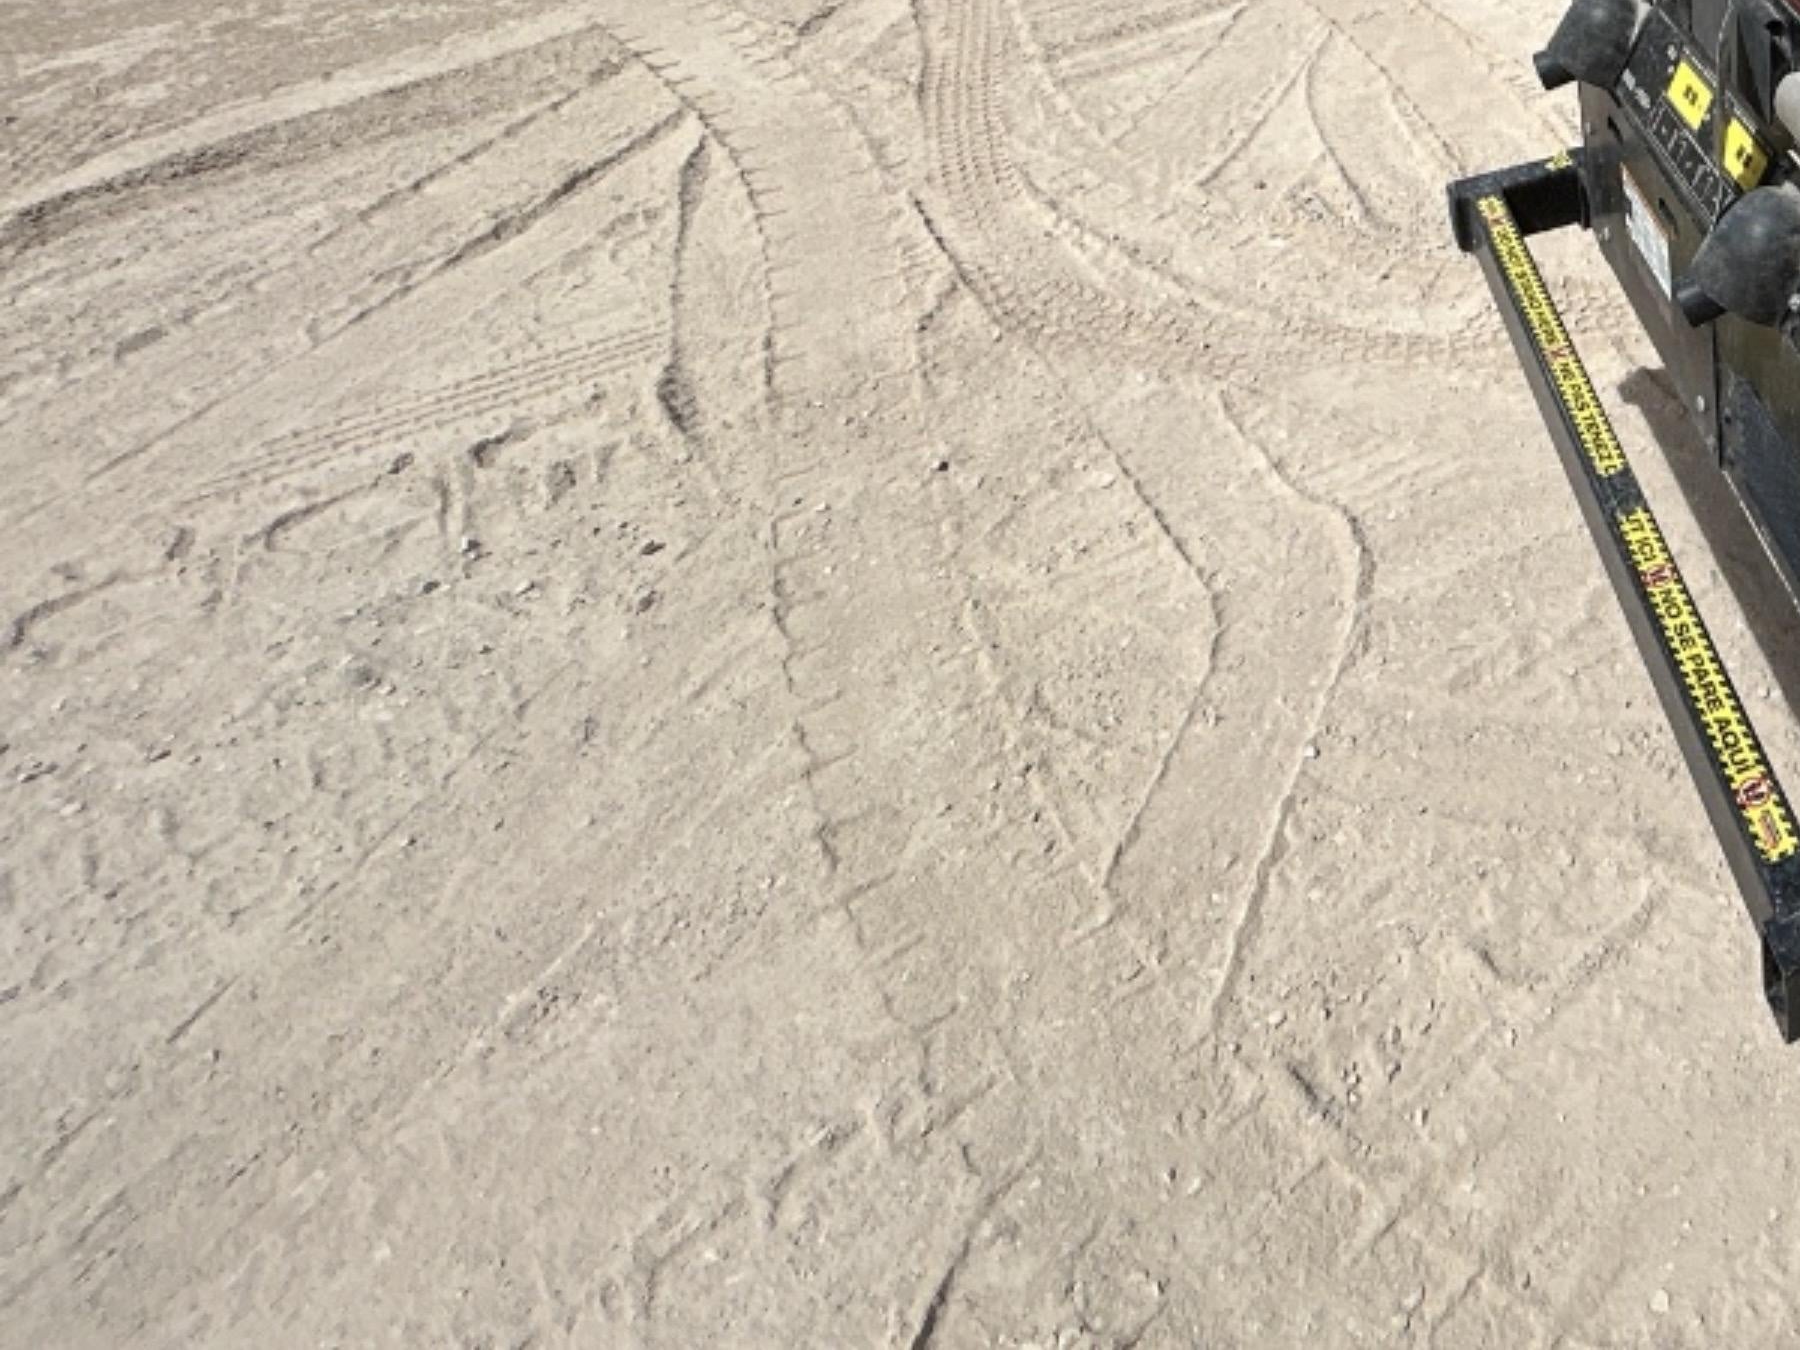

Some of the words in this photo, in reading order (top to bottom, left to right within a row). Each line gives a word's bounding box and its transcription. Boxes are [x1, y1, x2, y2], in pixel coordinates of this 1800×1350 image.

[1657, 586, 1681, 619] NO
[1672, 622, 1696, 651] SE
[1686, 653, 1725, 712] PARE
